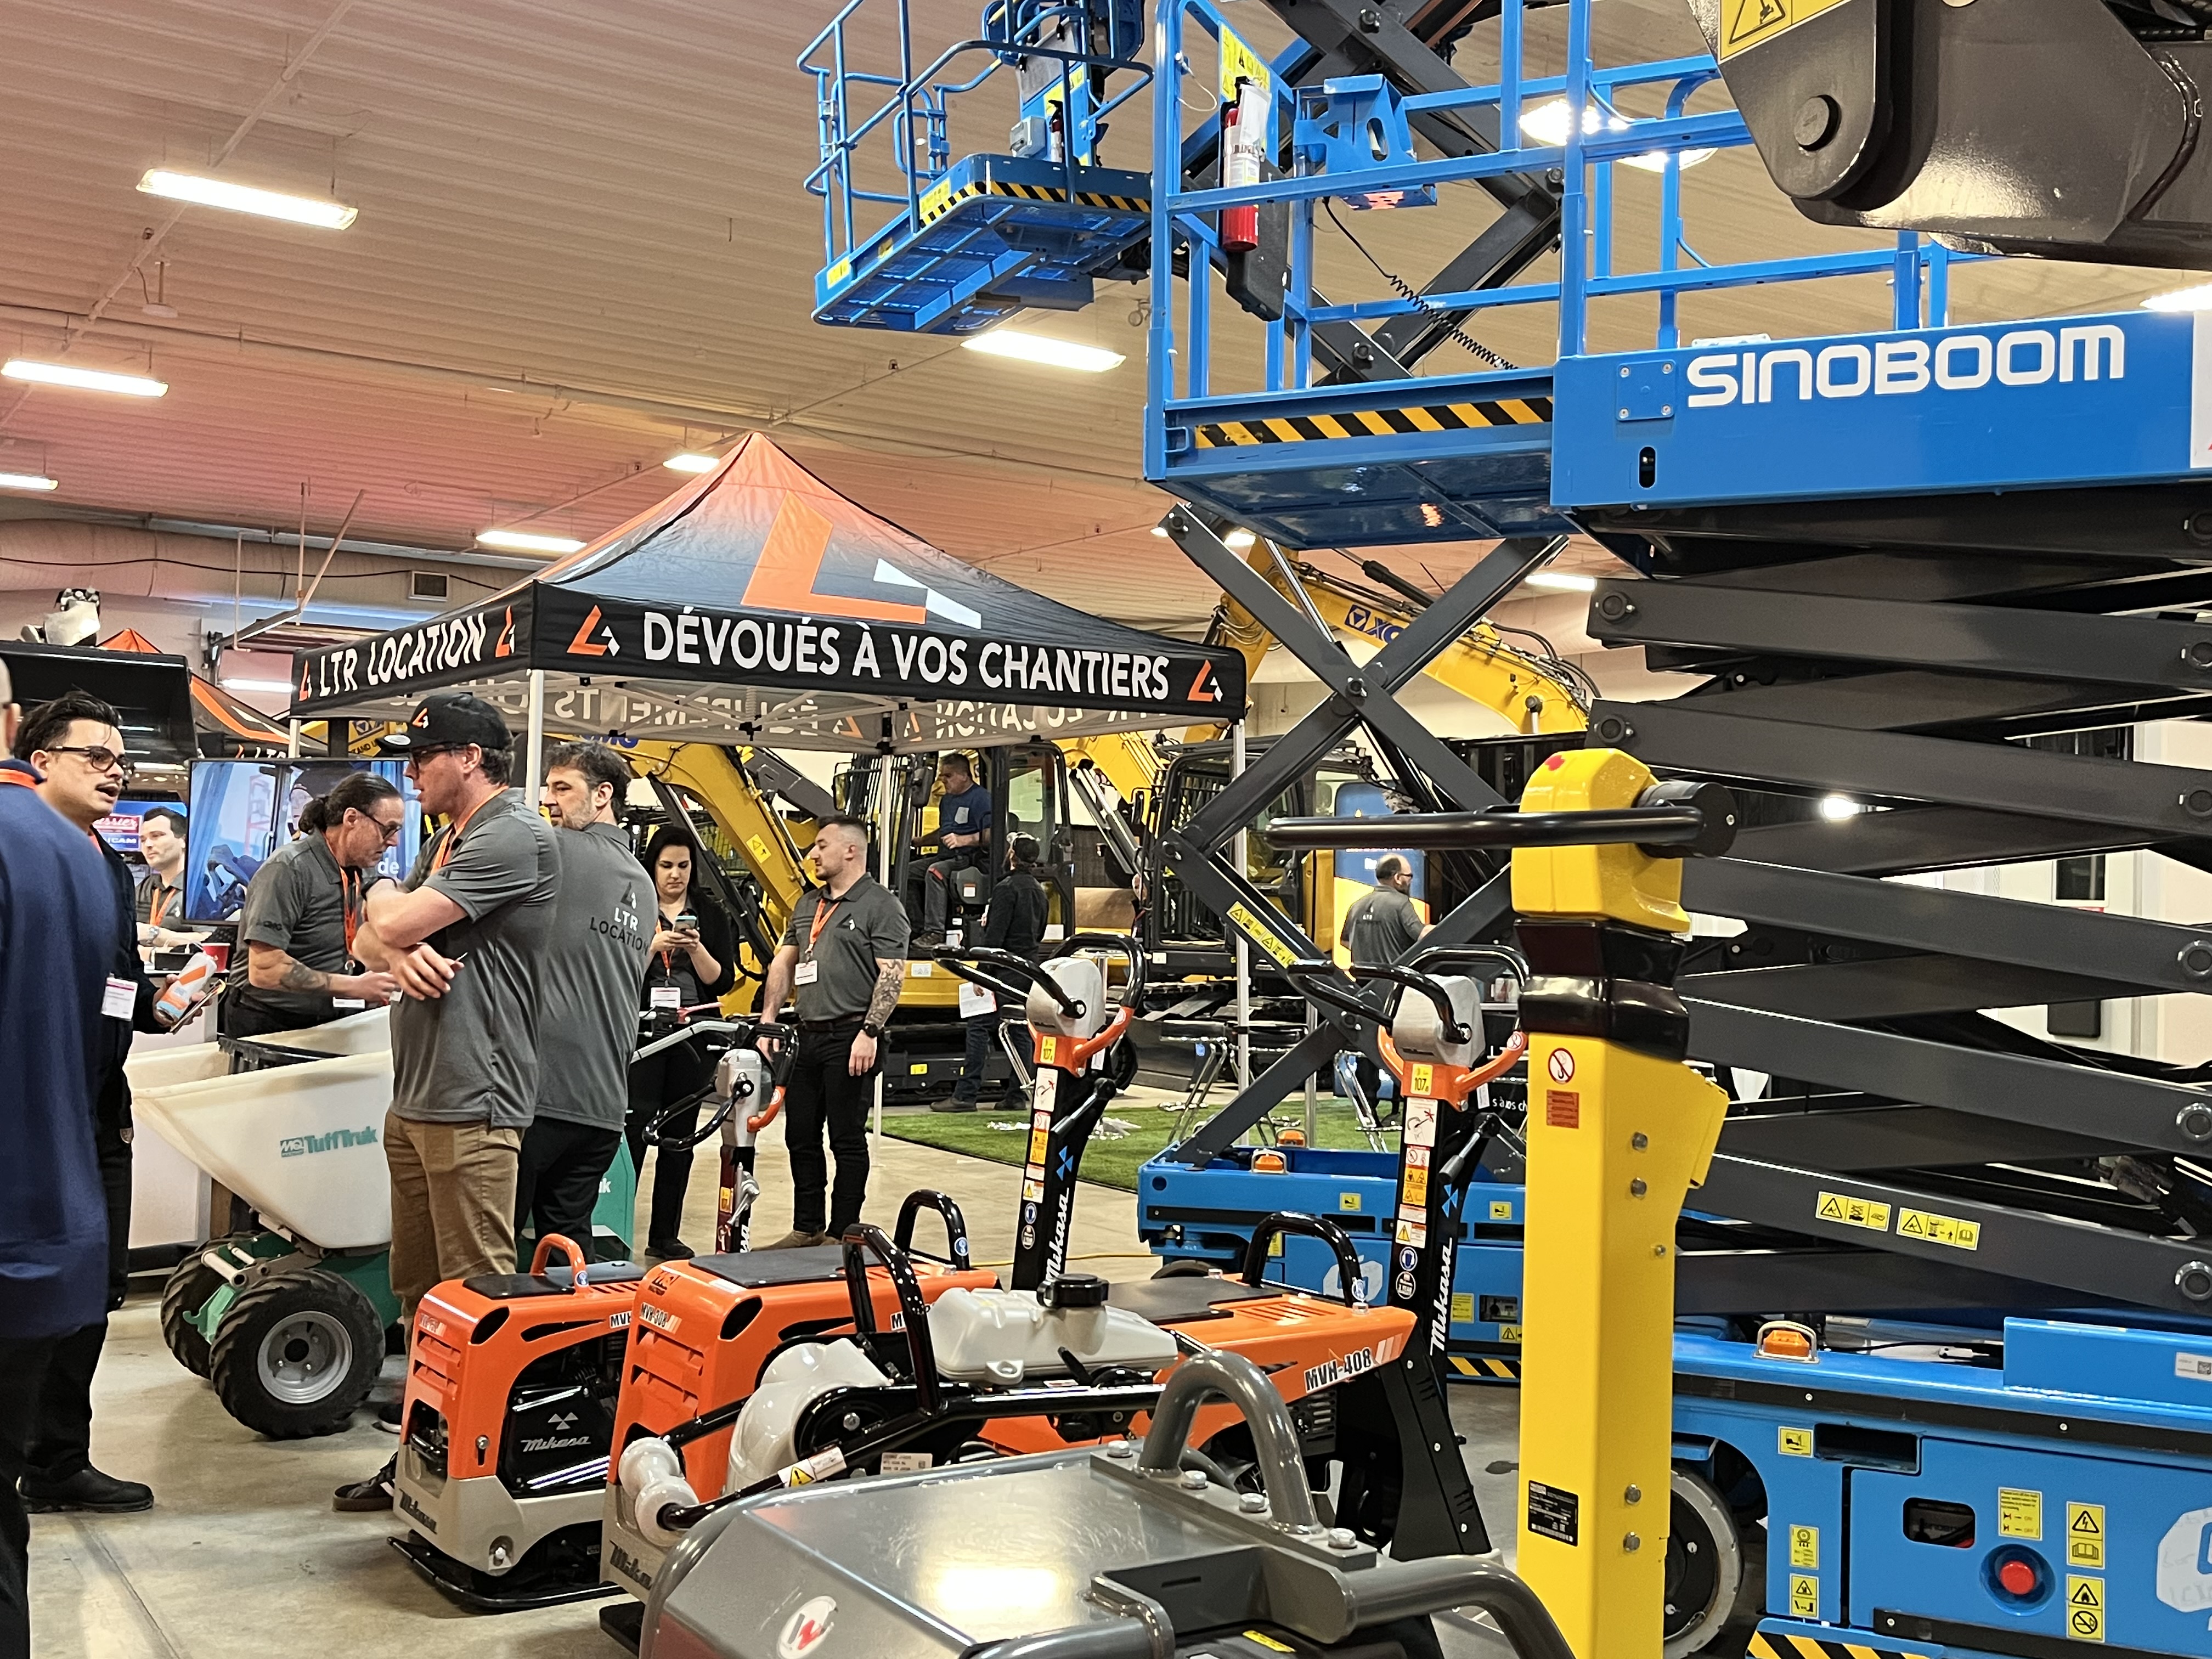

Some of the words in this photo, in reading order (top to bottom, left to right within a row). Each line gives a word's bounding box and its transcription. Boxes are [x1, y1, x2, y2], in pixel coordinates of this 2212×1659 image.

[1687, 324, 2125, 408] SINOBOOM
[319, 648, 358, 697] LTR
[368, 612, 487, 686] LOCATION
[644, 606, 839, 675] DÉVOUÉS
[852, 620, 881, 679] À
[891, 634, 968, 685] VOS
[980, 642, 1169, 700] CHANTIERS
[378, 857, 400, 876] de
[590, 916, 648, 956] LOCATION
[614, 907, 639, 932] LTR
[1045, 1187, 1070, 1283] Mikasa
[1430, 1237, 1453, 1356] Mikasa
[1305, 1348, 1372, 1391] MVH-408
[521, 1436, 591, 1452] Mikasa
